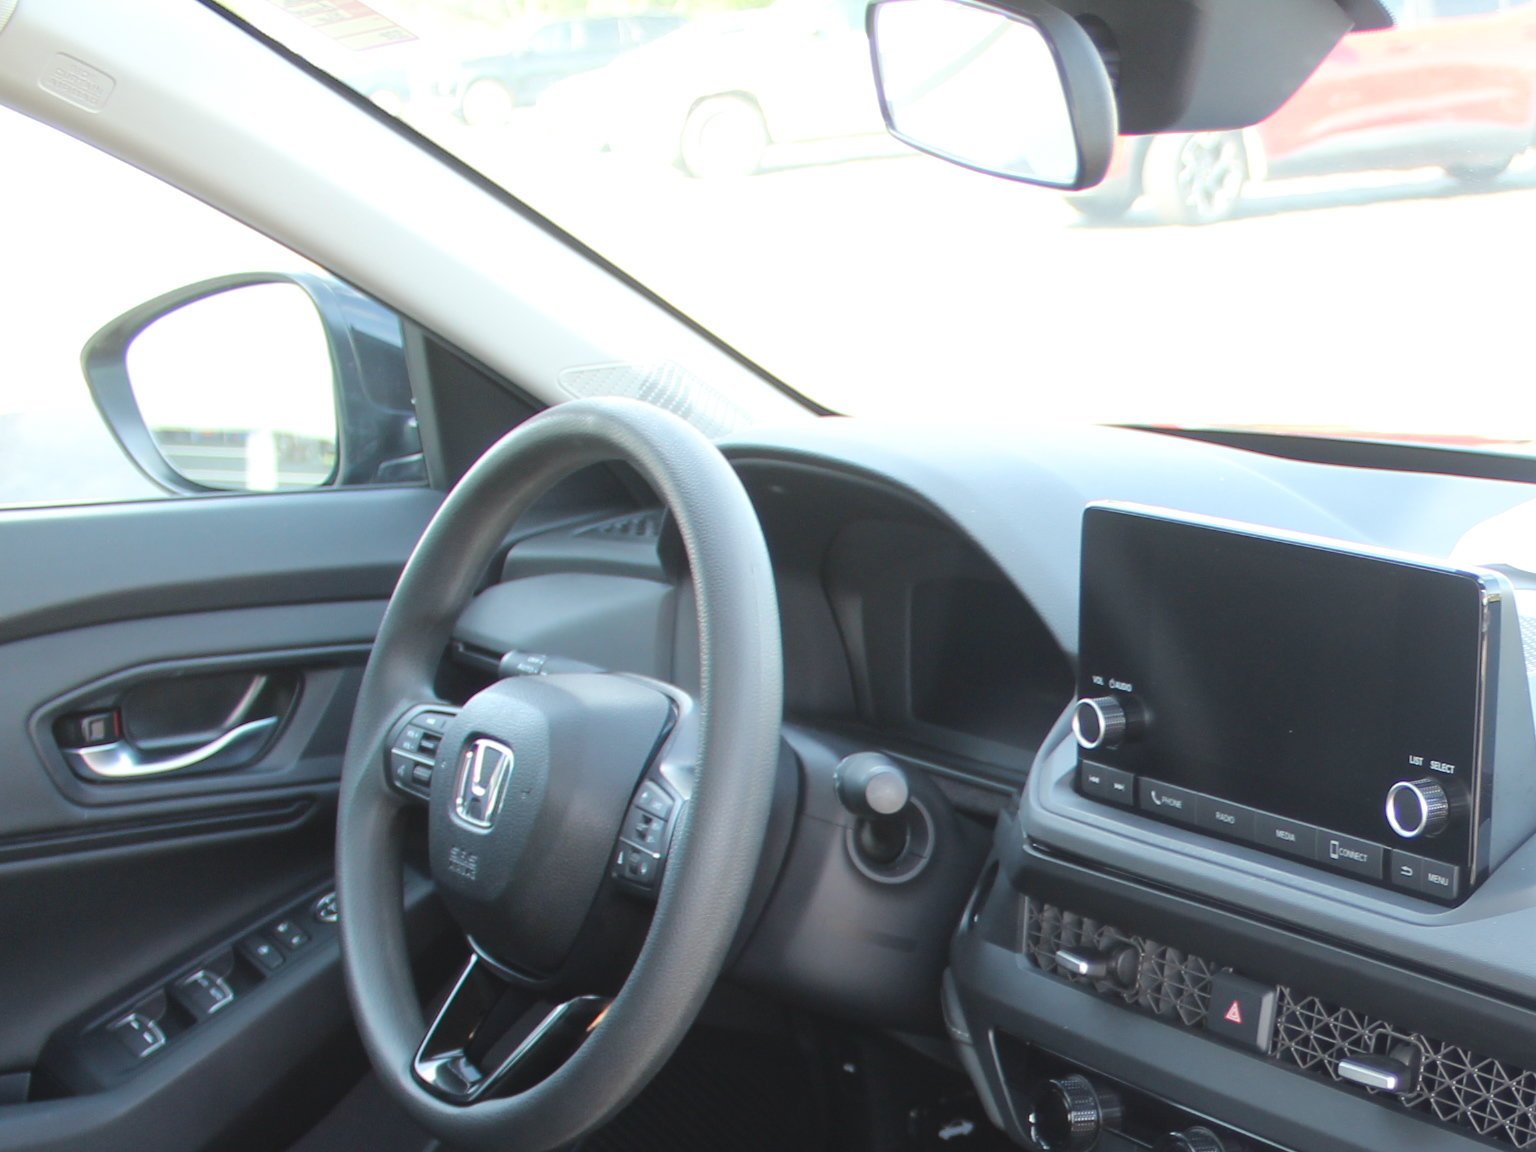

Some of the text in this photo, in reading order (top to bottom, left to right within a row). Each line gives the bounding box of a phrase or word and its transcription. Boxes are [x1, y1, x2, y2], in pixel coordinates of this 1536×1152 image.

[1091, 675, 1133, 692] VOL AUDIO
[1408, 754, 1455, 774] LIST SELECT
[1161, 795, 1183, 809] PHONE
[1215, 811, 1236, 825] RADIO
[1275, 828, 1296, 842] MEDIA
[1339, 847, 1368, 862] CONNECT
[1427, 872, 1449, 886] MENU
